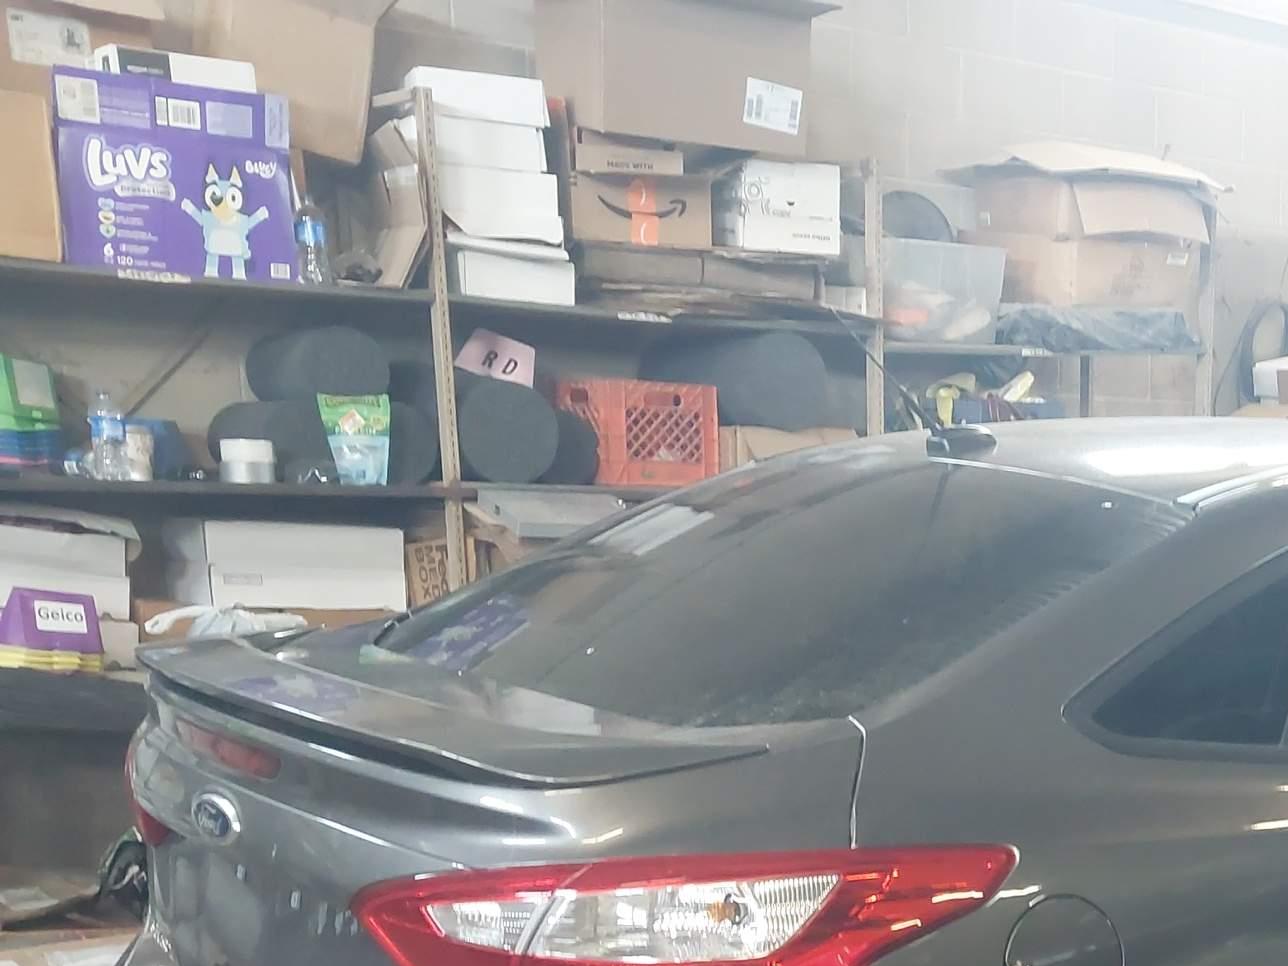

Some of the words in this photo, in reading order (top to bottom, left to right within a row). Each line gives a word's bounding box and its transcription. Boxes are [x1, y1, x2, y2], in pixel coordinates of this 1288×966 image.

[87, 137, 168, 187] Luvs
[481, 350, 498, 369] R
[502, 357, 518, 375] D
